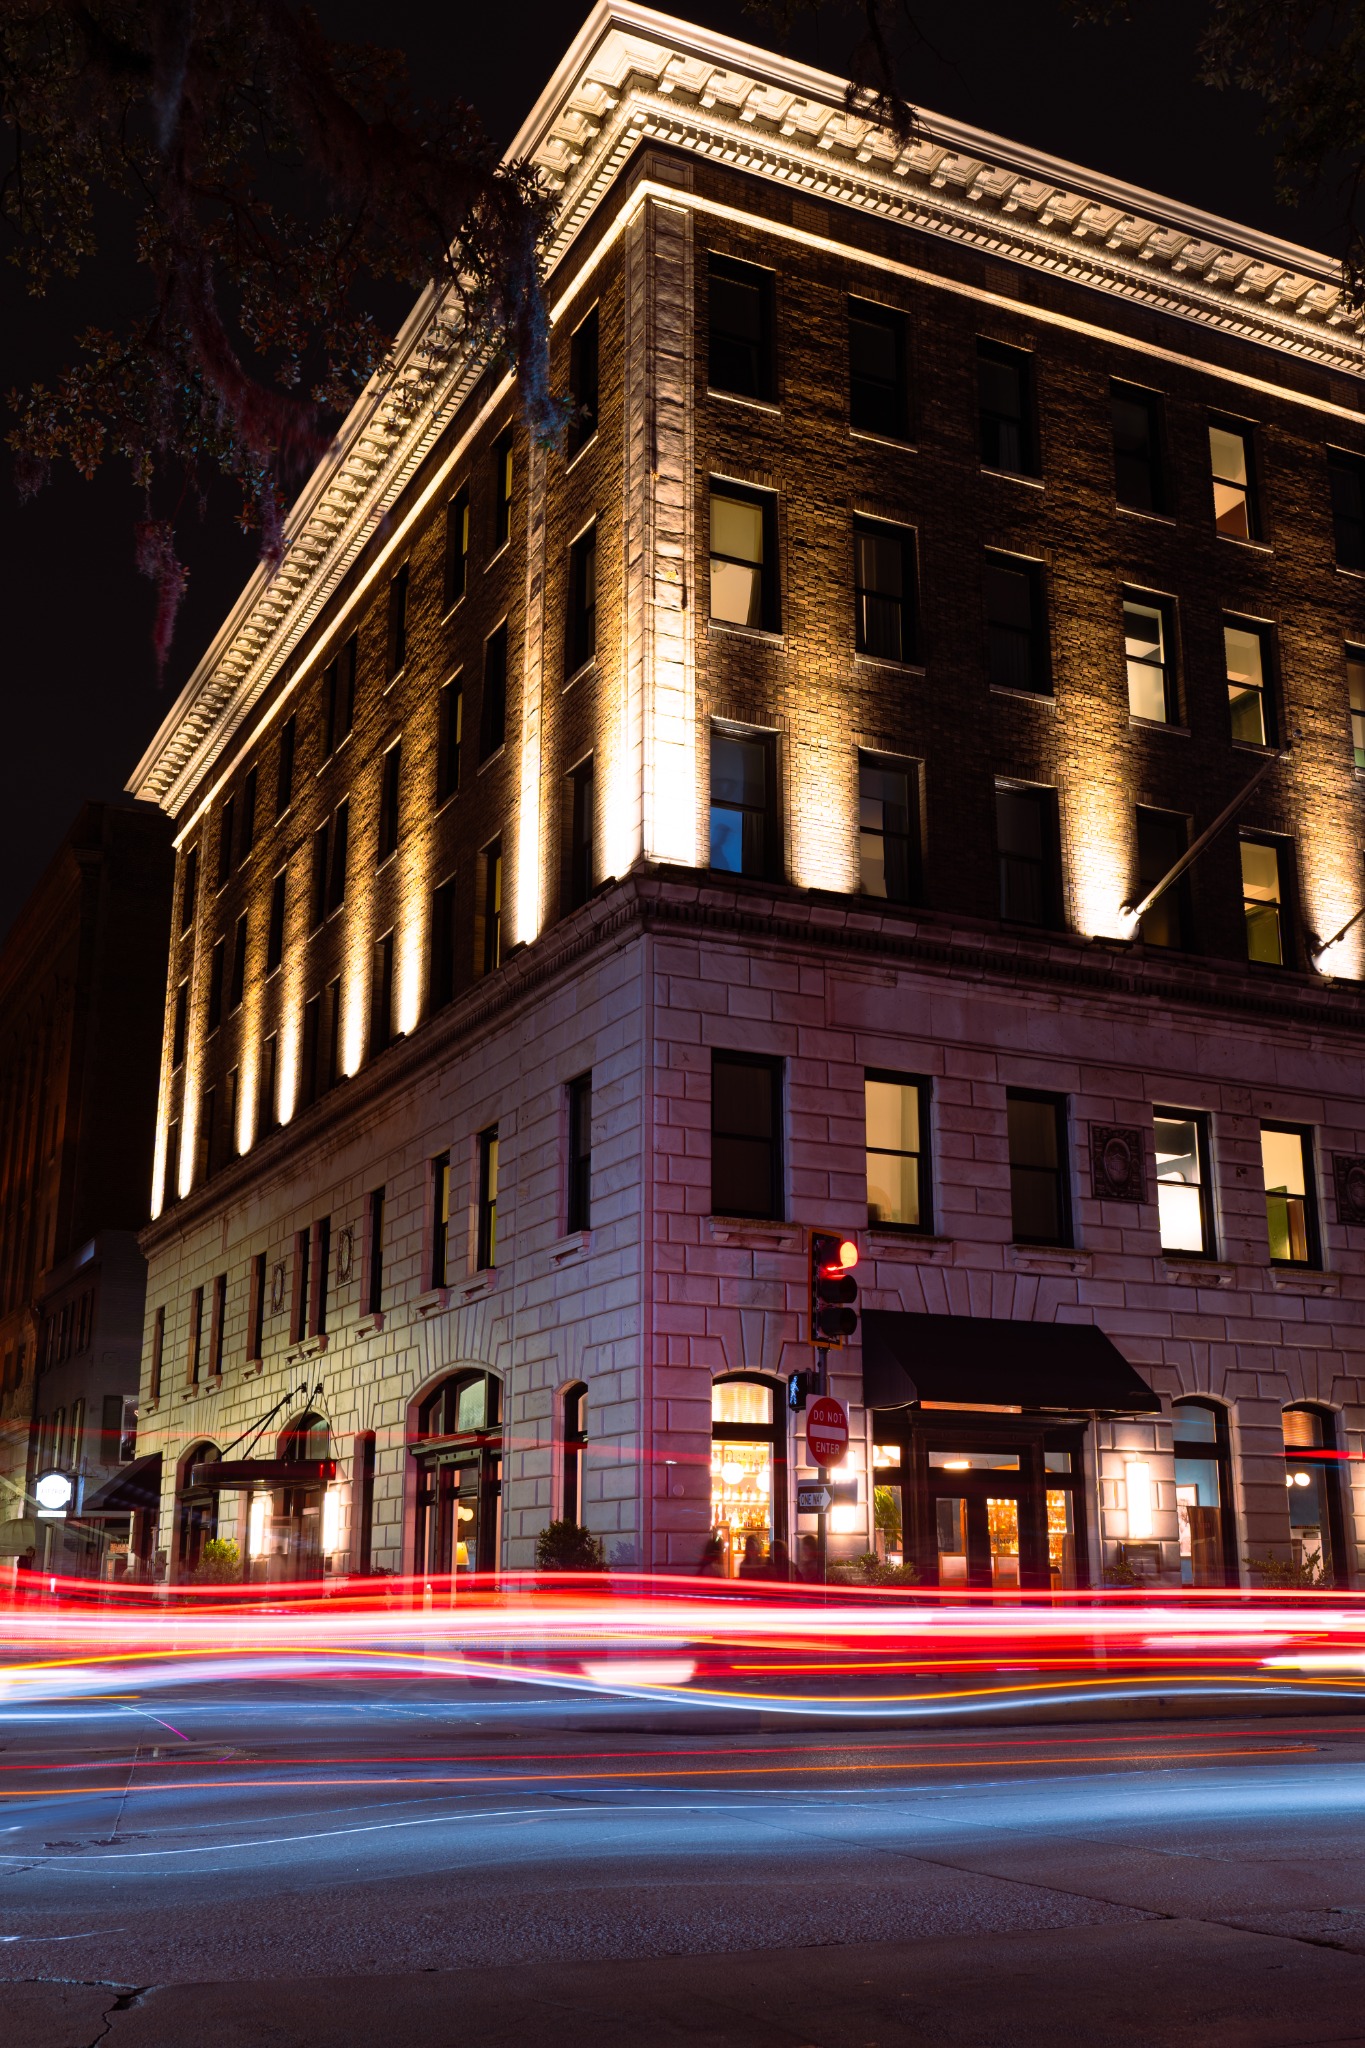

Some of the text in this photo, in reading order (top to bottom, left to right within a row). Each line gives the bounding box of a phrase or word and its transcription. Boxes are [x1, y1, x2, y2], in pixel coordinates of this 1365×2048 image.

[813, 1410, 843, 1424] DO NOT
[815, 1441, 840, 1455] ENTER
[800, 1493, 824, 1506] ONE WAY
